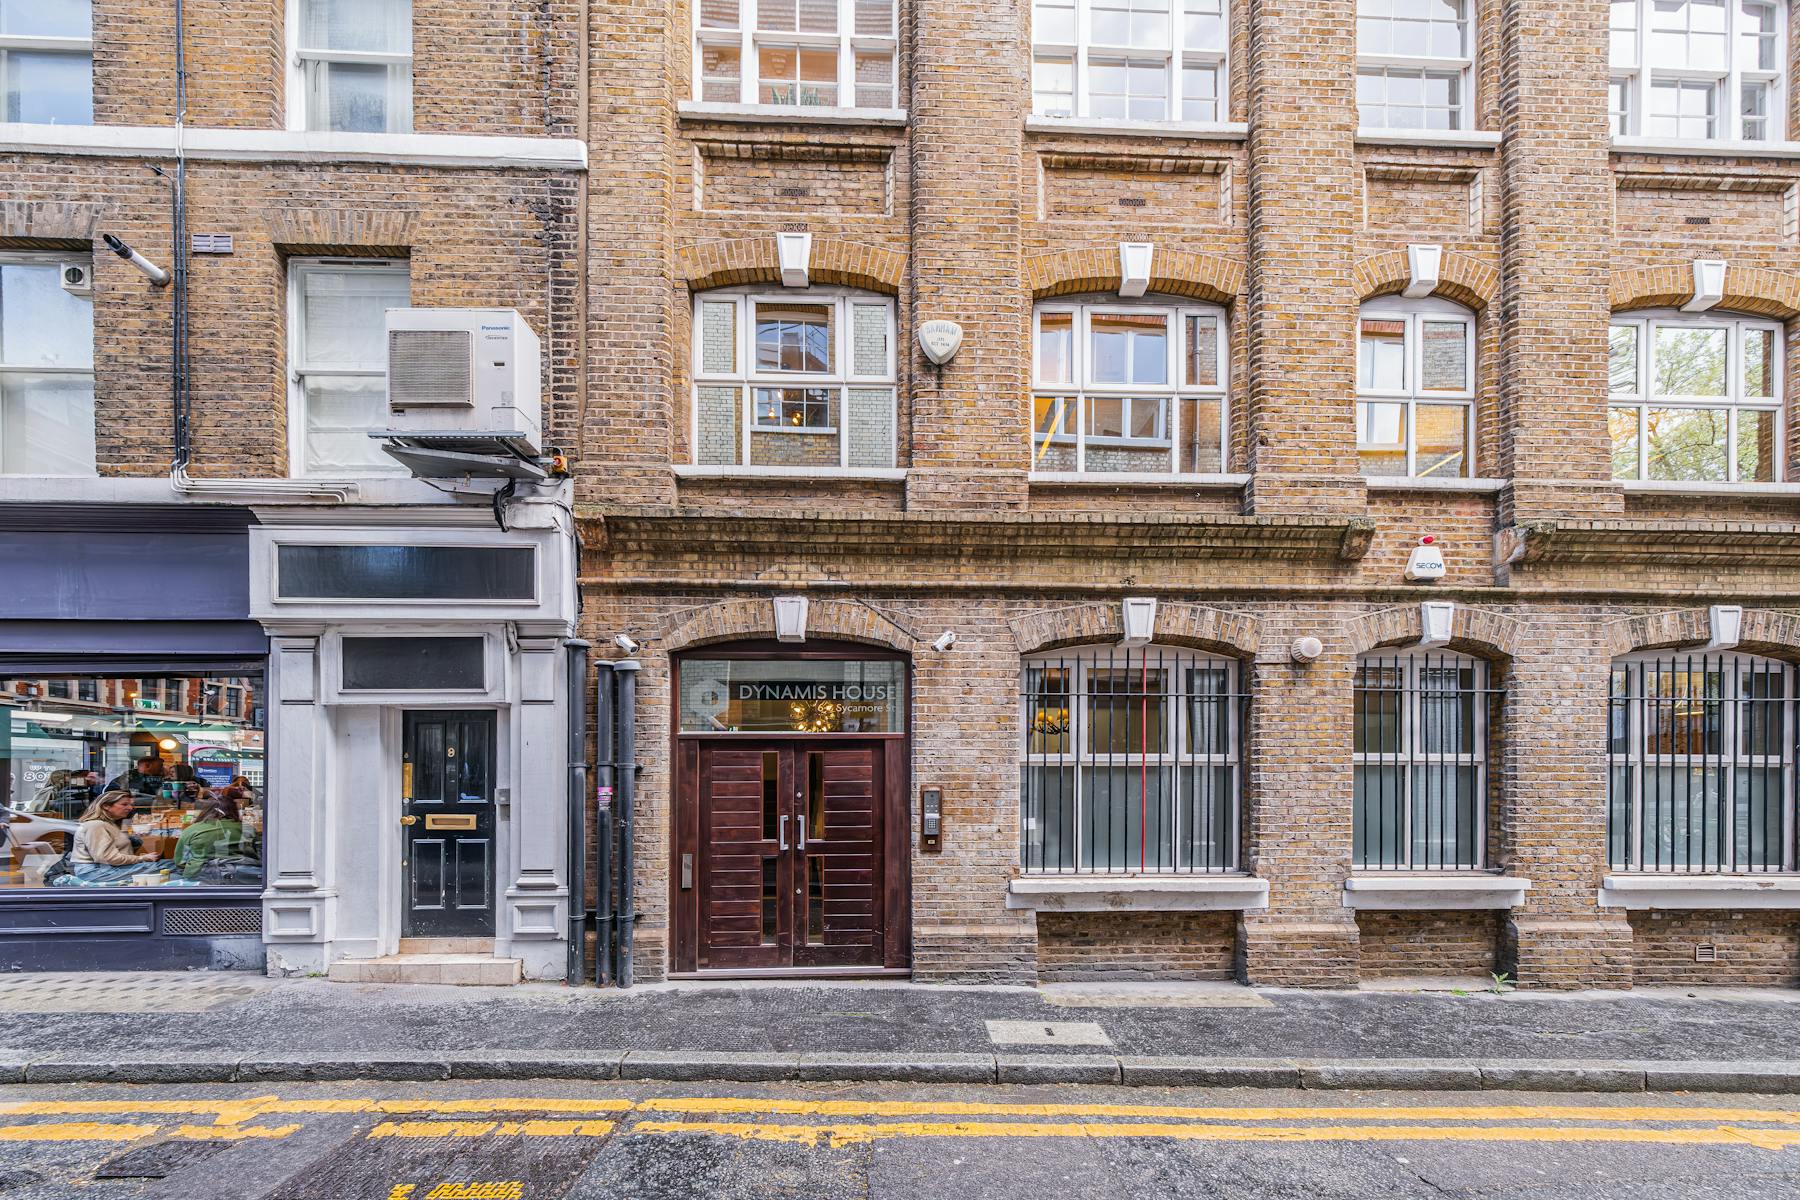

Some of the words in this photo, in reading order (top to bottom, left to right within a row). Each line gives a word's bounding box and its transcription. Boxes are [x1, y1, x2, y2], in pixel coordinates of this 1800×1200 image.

[739, 685, 827, 700] DYNAMIS
[832, 685, 896, 700] HOUSE
[835, 703, 883, 714] Sycamore
